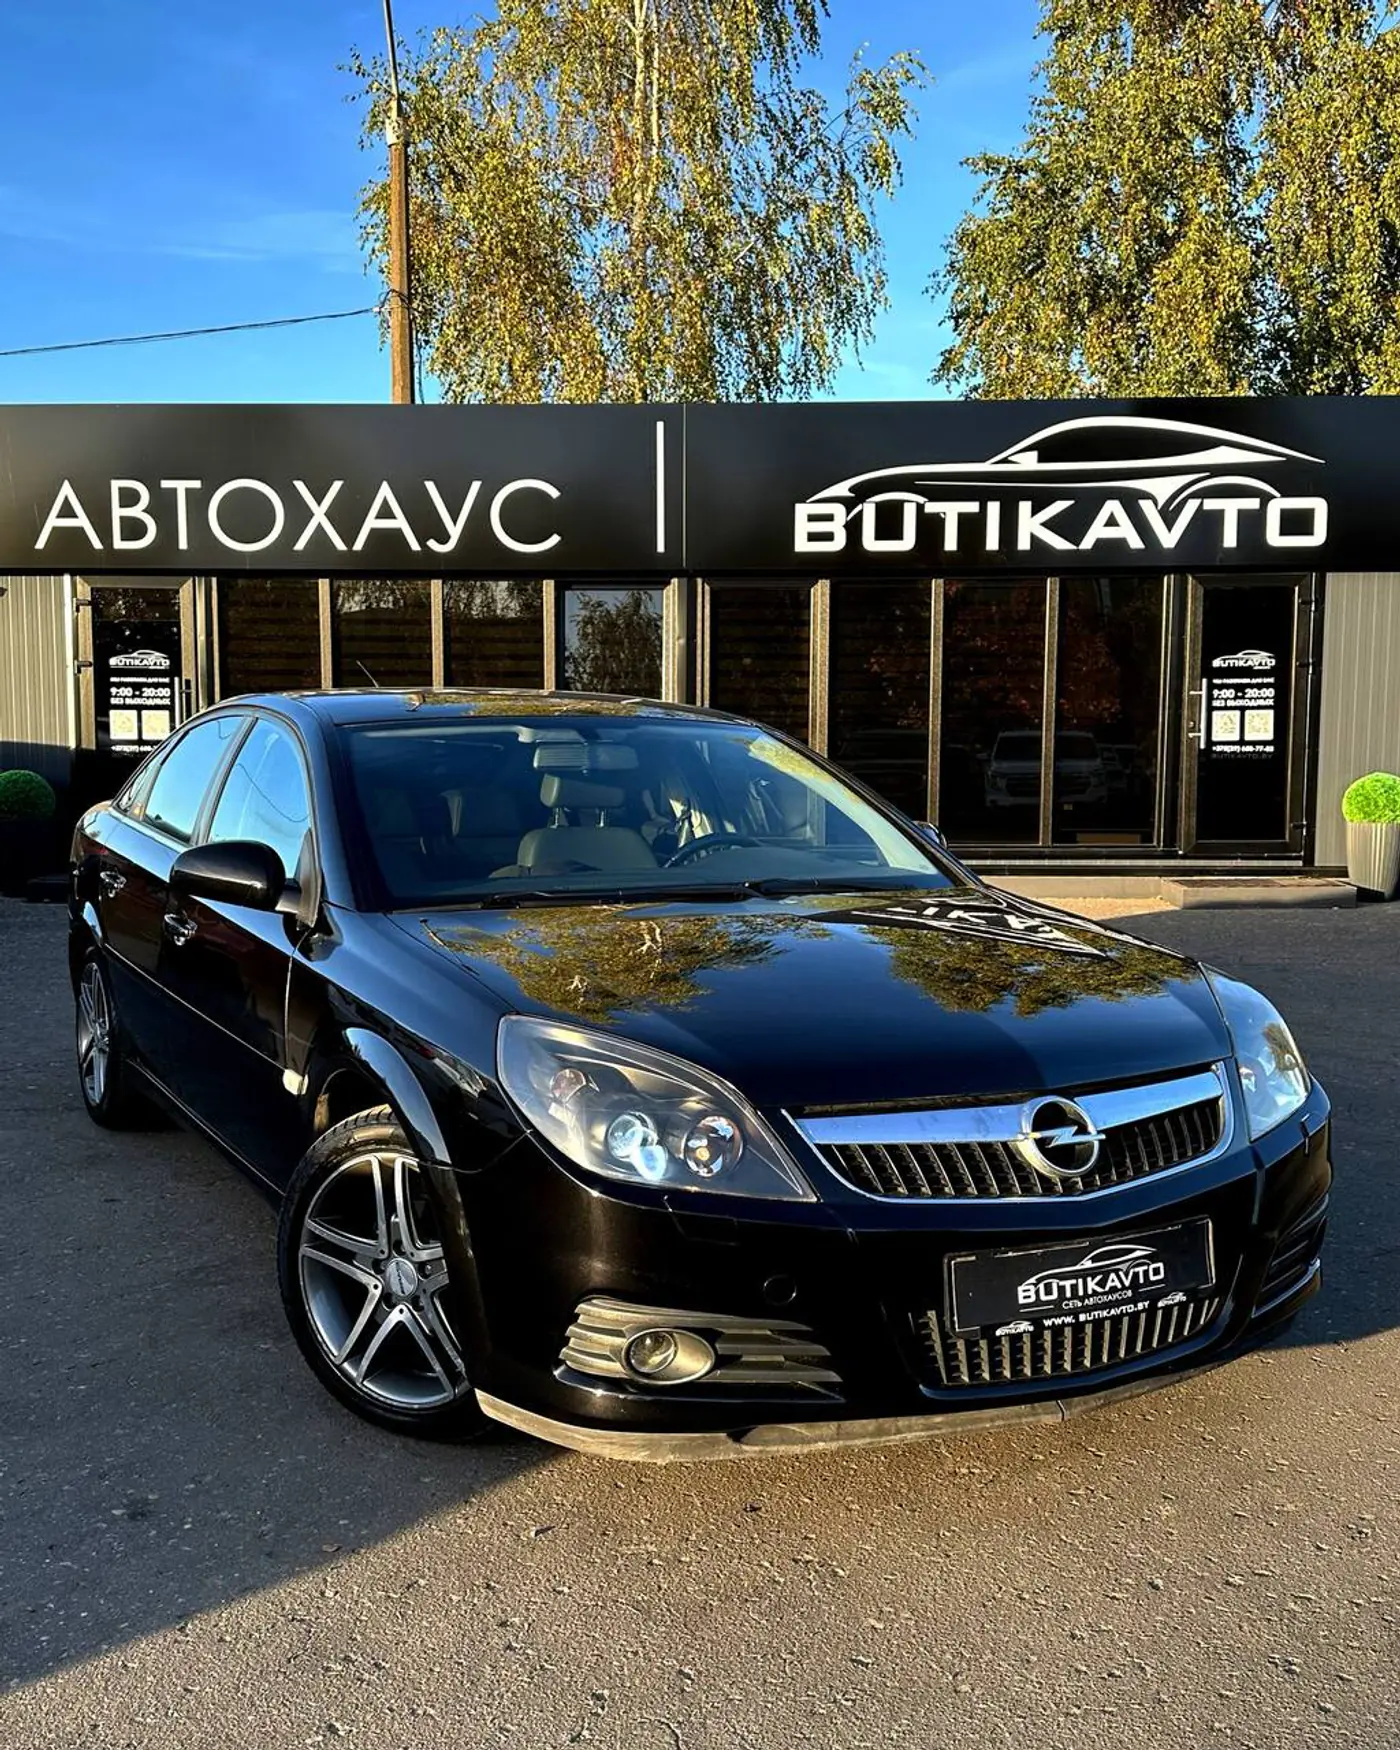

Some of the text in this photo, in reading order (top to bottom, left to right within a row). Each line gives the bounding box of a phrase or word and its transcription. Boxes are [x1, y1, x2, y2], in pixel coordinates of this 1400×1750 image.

[34, 478, 562, 553] АВТОХАУС
[793, 495, 1329, 553] BUTIKAVTO
[110, 687, 133, 697] 9:00
[141, 687, 171, 697] 20:00
[1212, 688, 1236, 698] 9:00
[1244, 687, 1276, 698] 20:00
[1016, 1262, 1164, 1305] BUTIKAVTO
[1062, 1289, 1133, 1310] СЕТЬ АВТОХАУСОВ
[1043, 1315, 1076, 1327] WWW.
[1078, 1300, 1150, 1322] BUTIKAVTO.BY
